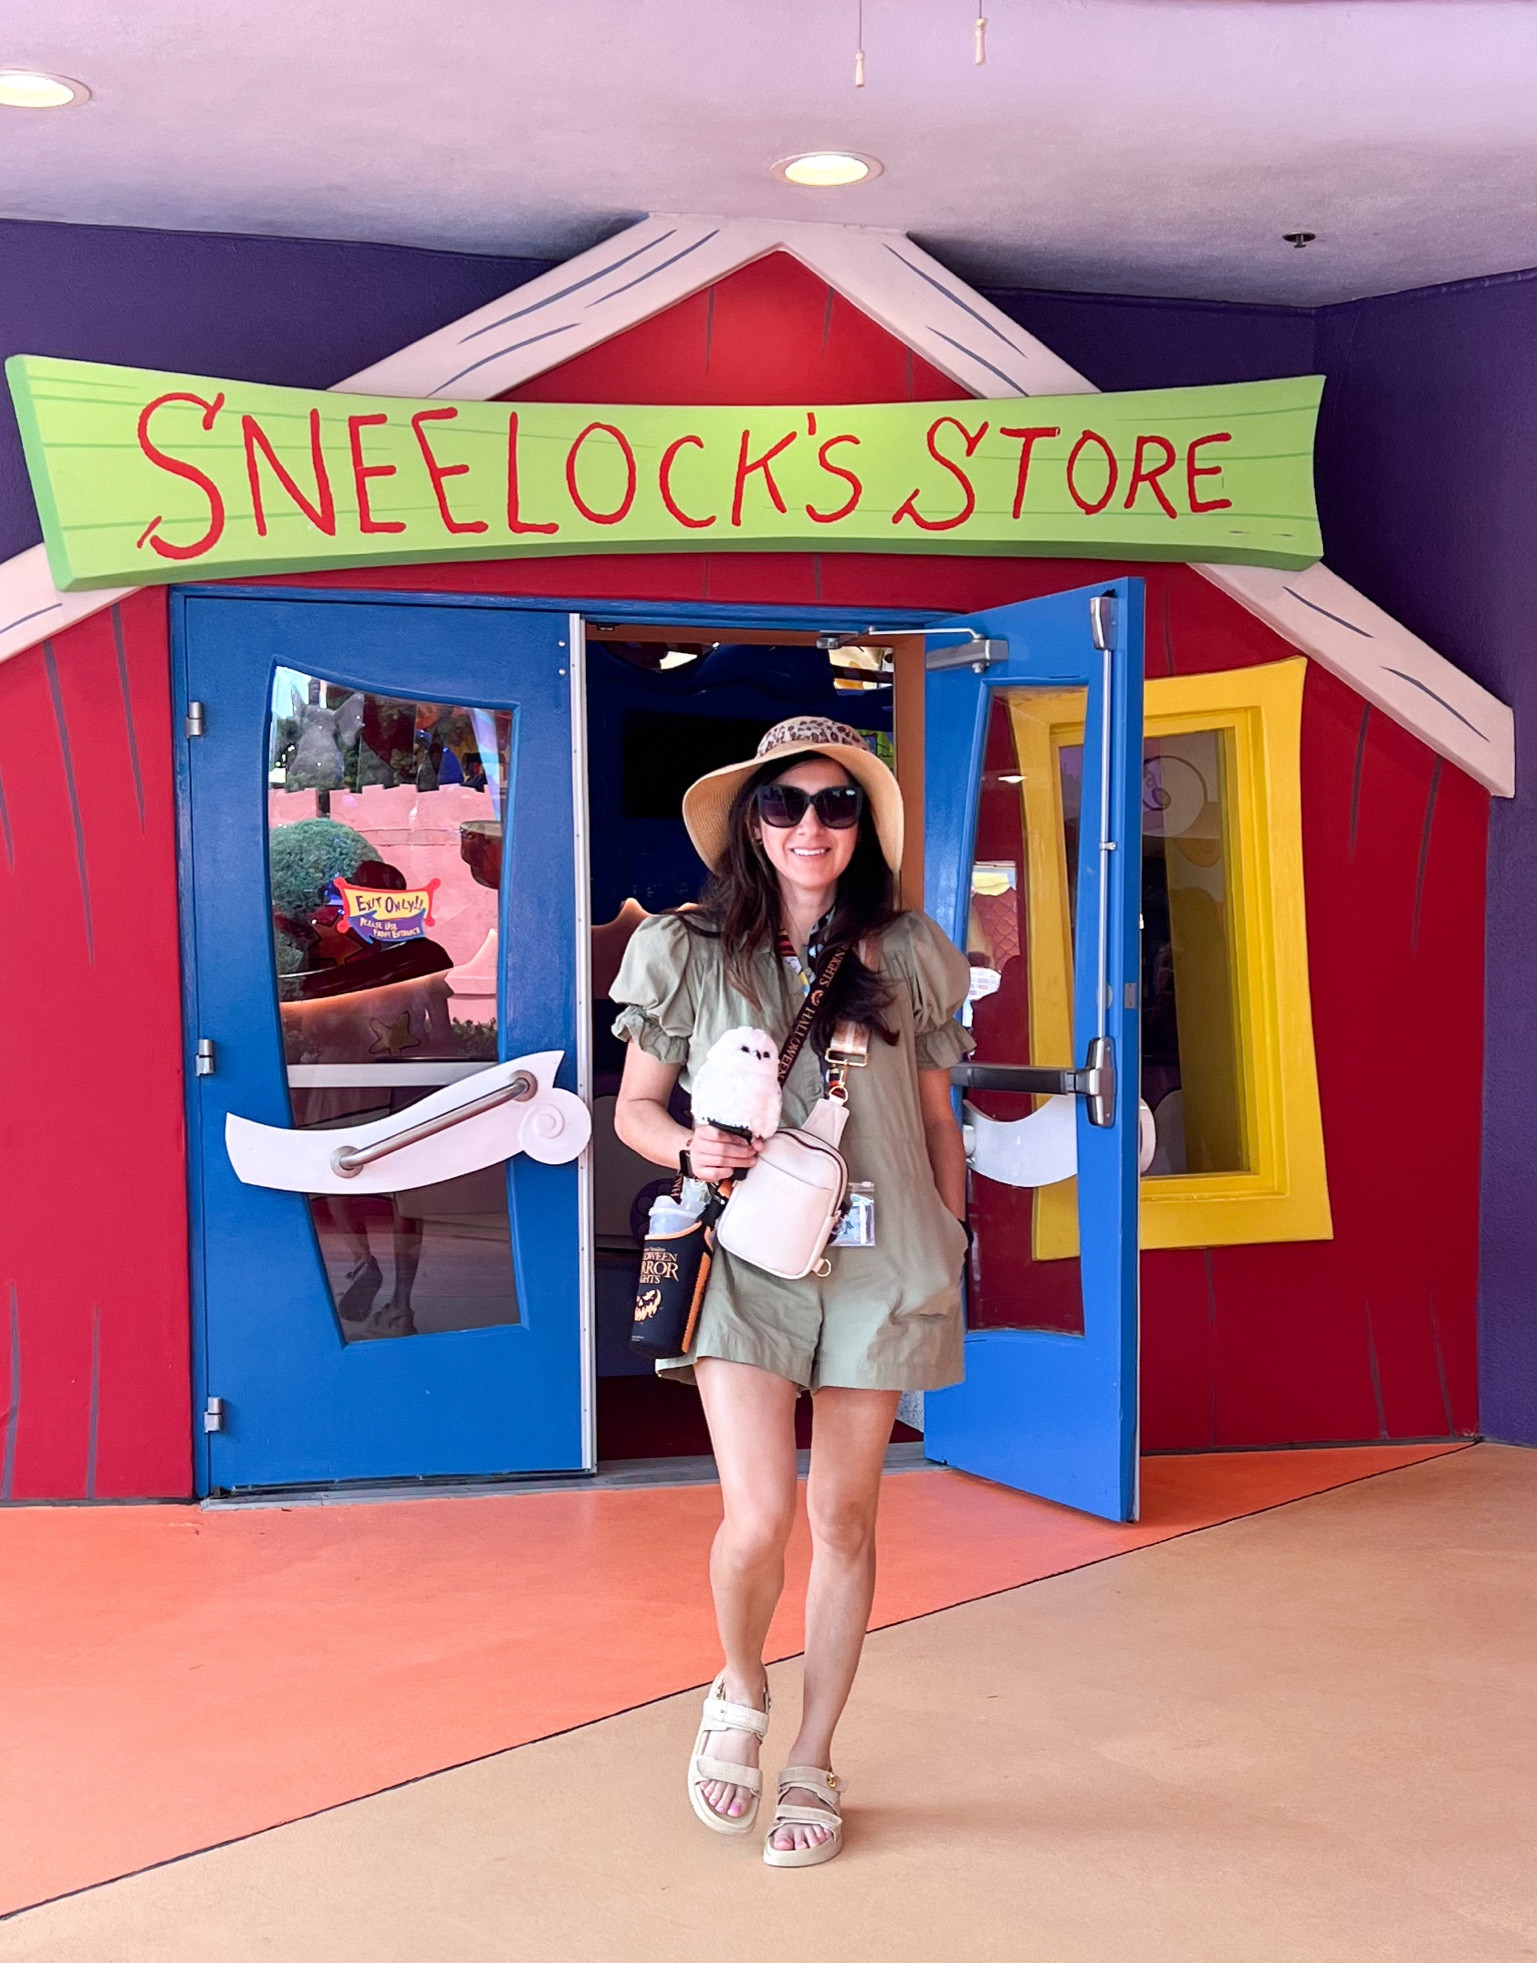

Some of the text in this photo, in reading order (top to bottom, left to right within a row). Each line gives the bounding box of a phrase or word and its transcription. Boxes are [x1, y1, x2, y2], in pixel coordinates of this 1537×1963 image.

[136, 391, 1232, 561] SNEELOCK'S STORE
[355, 895, 424, 913] EXIT ONLY!!
[360, 917, 382, 929] PLEASE
[373, 928, 420, 938] FRONT ENTRANCE
[819, 951, 846, 987] NIGHTS
